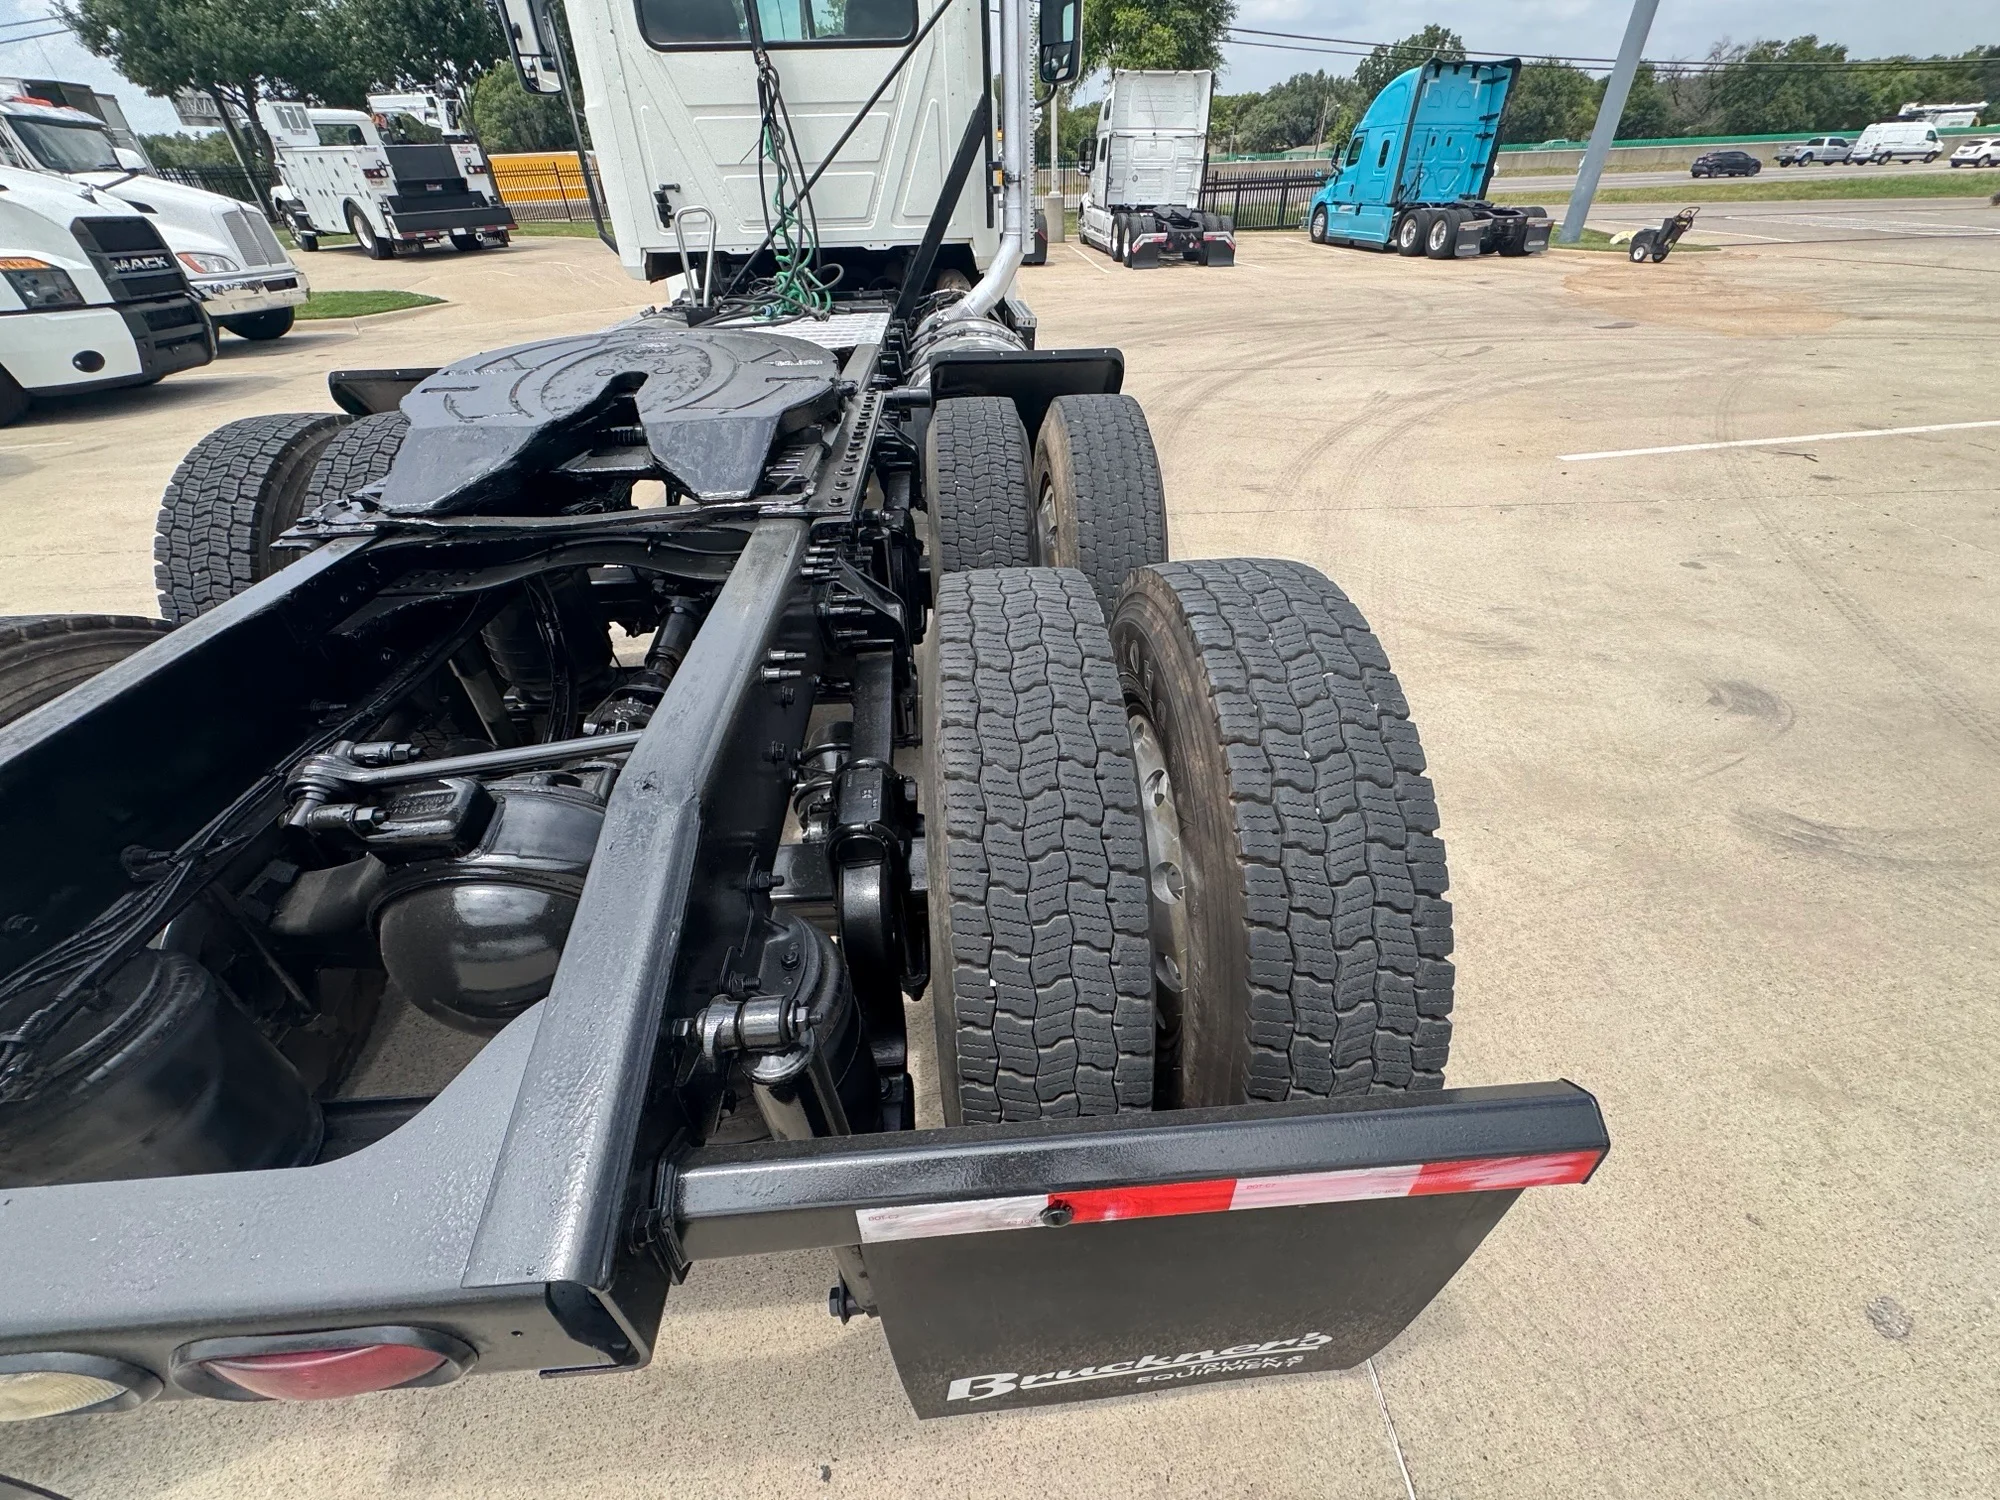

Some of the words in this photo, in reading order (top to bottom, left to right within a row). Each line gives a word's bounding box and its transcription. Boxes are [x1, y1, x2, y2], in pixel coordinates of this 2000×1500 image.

[113, 256, 170, 272] MACK
[1136, 1359, 1302, 1384] EQUIPMENT
[1186, 1356, 1280, 1371] TRUCK
